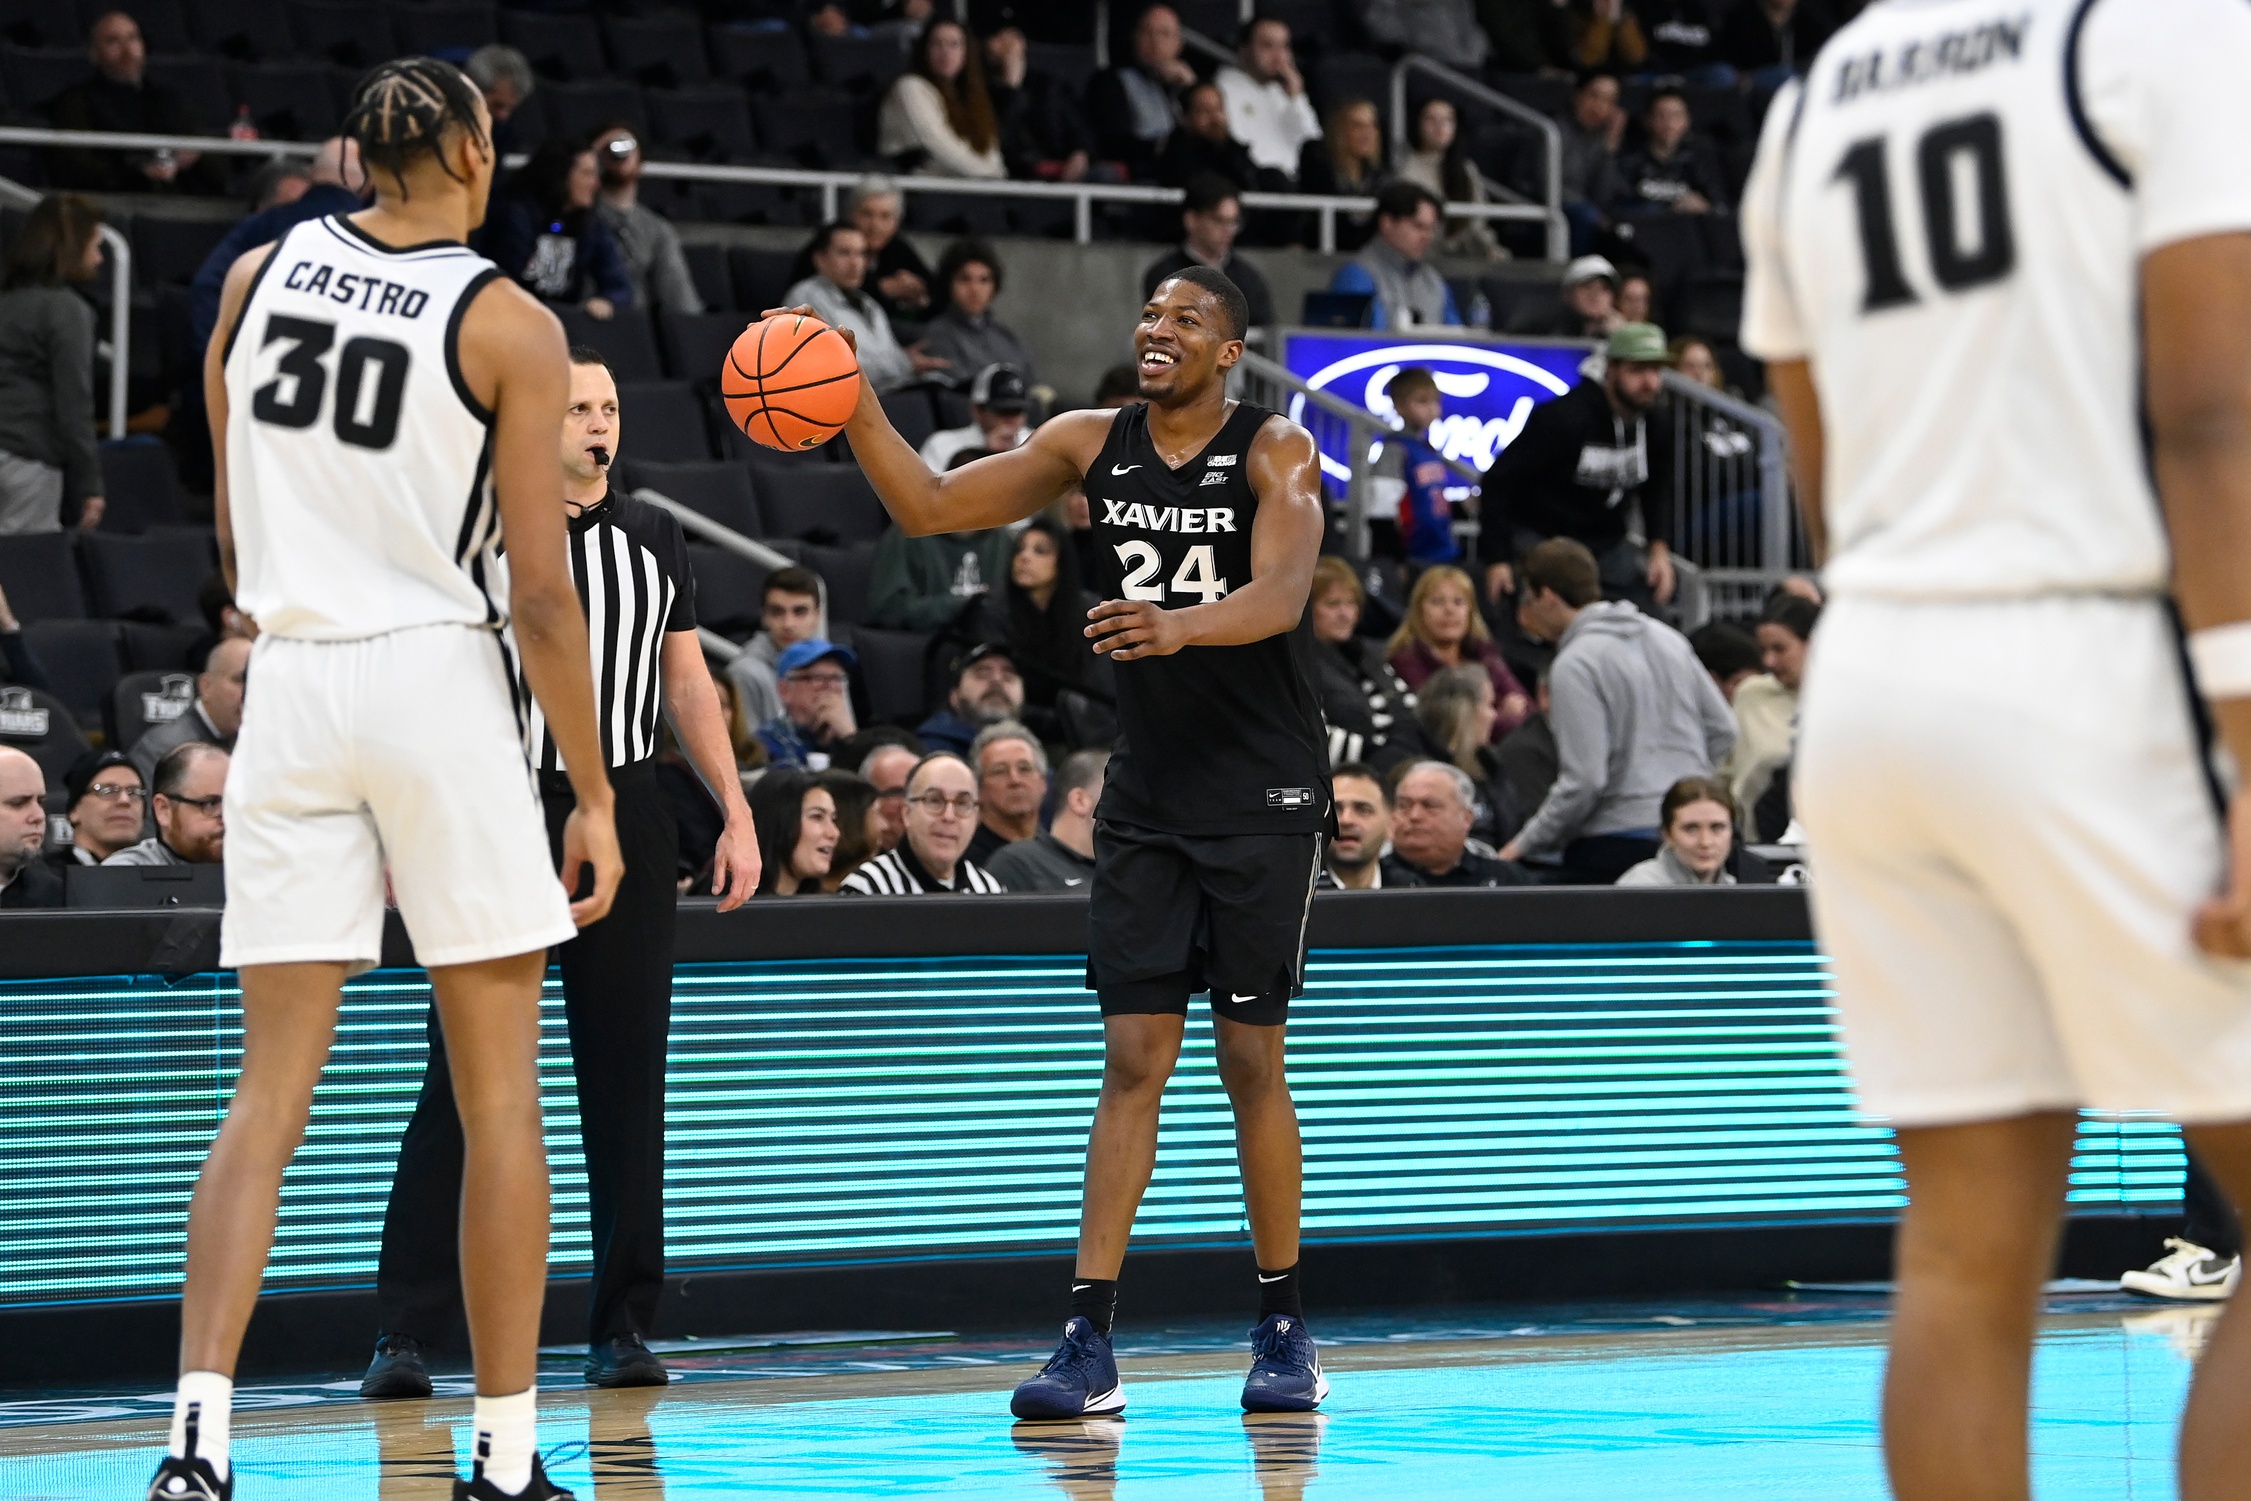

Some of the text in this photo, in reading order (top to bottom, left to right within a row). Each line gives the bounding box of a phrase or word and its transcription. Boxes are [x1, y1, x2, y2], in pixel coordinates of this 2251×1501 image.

[1823, 110, 2018, 314] 10
[284, 261, 430, 320] CASTRO
[252, 312, 411, 451] 30
[1100, 498, 1238, 533] XAVIER
[1113, 540, 1228, 604] 24
[1302, 792, 1310, 800] 50
